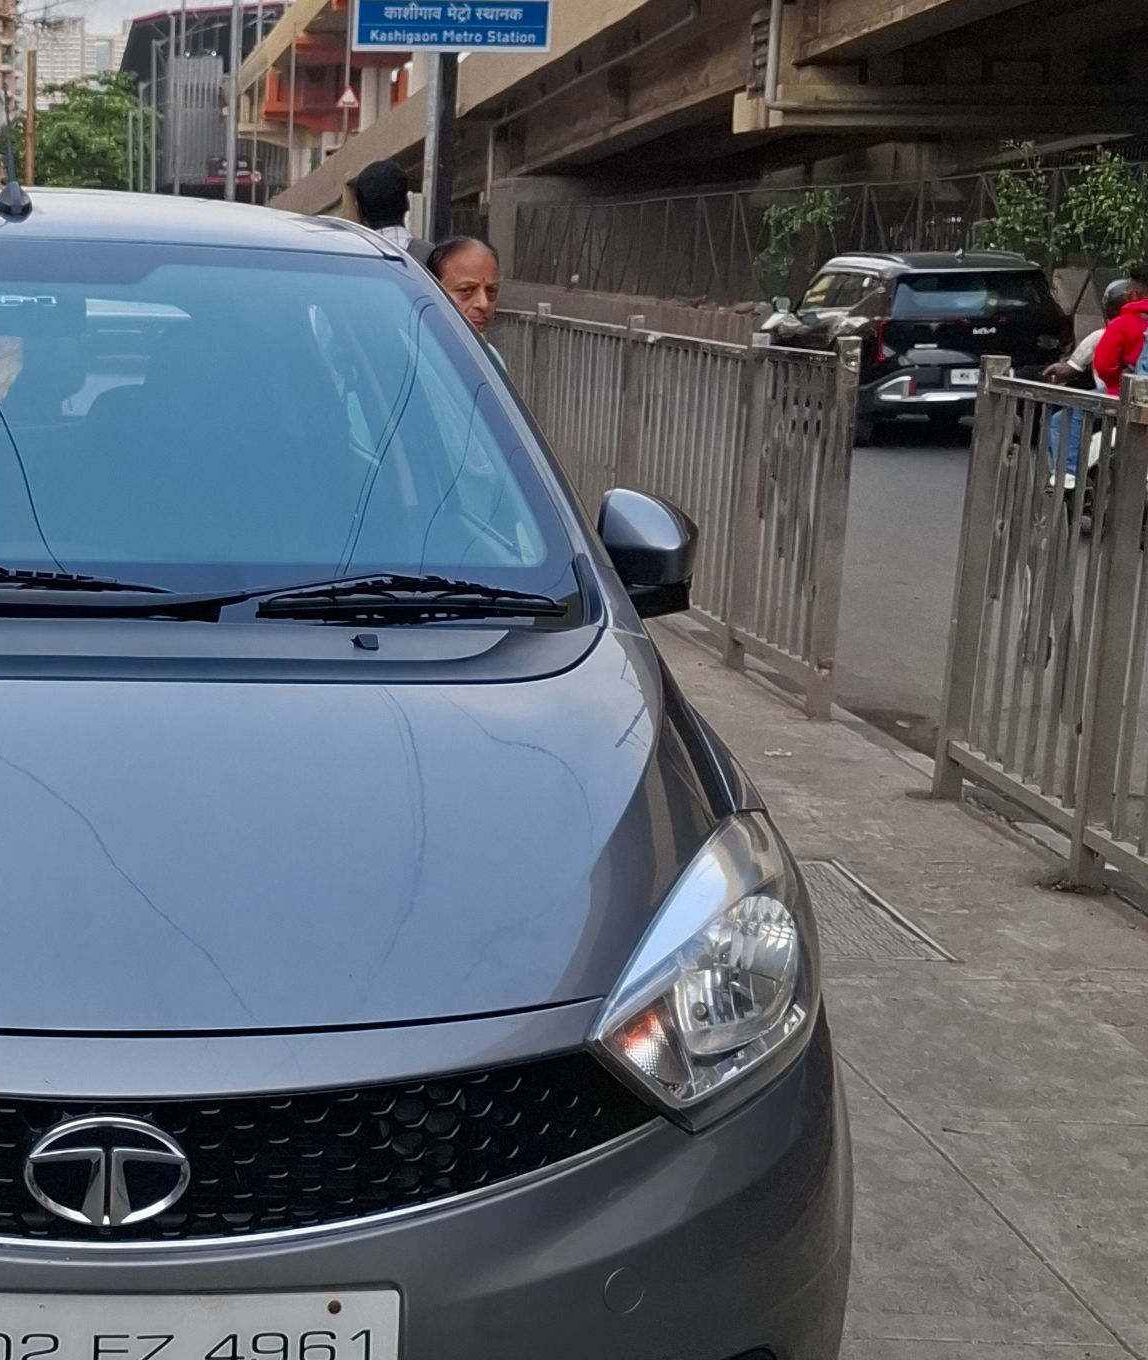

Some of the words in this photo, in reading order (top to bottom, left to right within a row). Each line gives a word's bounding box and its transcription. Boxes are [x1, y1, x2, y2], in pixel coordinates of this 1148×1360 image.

[384, 1, 442, 21] काशीगाव
[446, 2, 471, 23] मेट्रो
[475, 6, 524, 22] स्थानक
[369, 29, 438, 45] Kashigaon
[442, 29, 483, 43] Metro
[486, 29, 536, 44] Station
